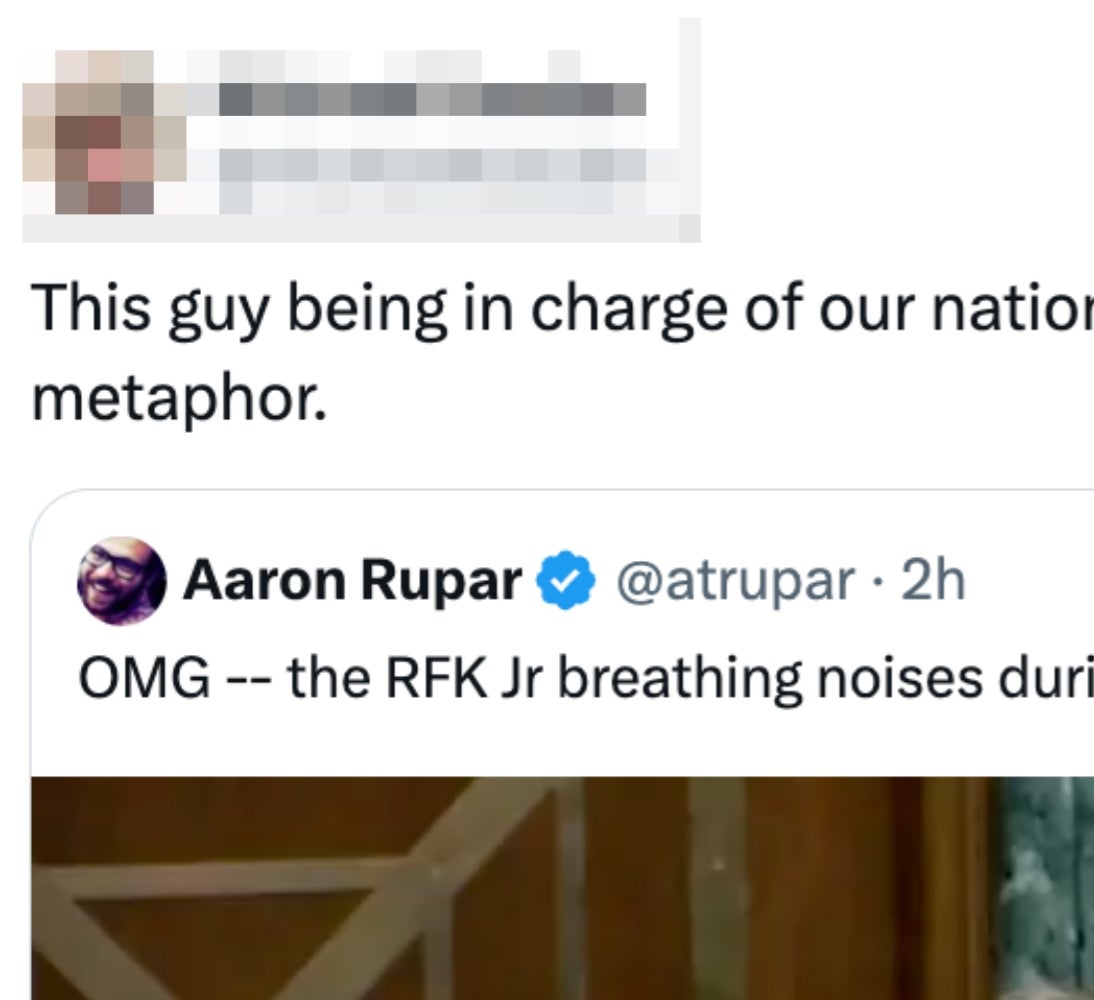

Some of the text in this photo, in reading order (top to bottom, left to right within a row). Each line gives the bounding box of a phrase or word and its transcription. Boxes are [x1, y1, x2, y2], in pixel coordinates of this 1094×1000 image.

[30, 280, 151, 331] This
[169, 288, 271, 343] guy
[290, 280, 448, 343] being
[465, 281, 512, 330] in
[532, 280, 727, 343] charge
[745, 279, 804, 331] of
[820, 294, 916, 331] our
[34, 370, 326, 433] metaphor.
[182, 555, 964, 611] Aaron Rupar @atrupar 2h
[79, 655, 209, 699] OMG
[286, 653, 370, 698] the
[388, 656, 488, 698] RFK
[501, 656, 543, 699] Jr
[559, 653, 803, 710] breathing
[819, 654, 983, 699] noises
